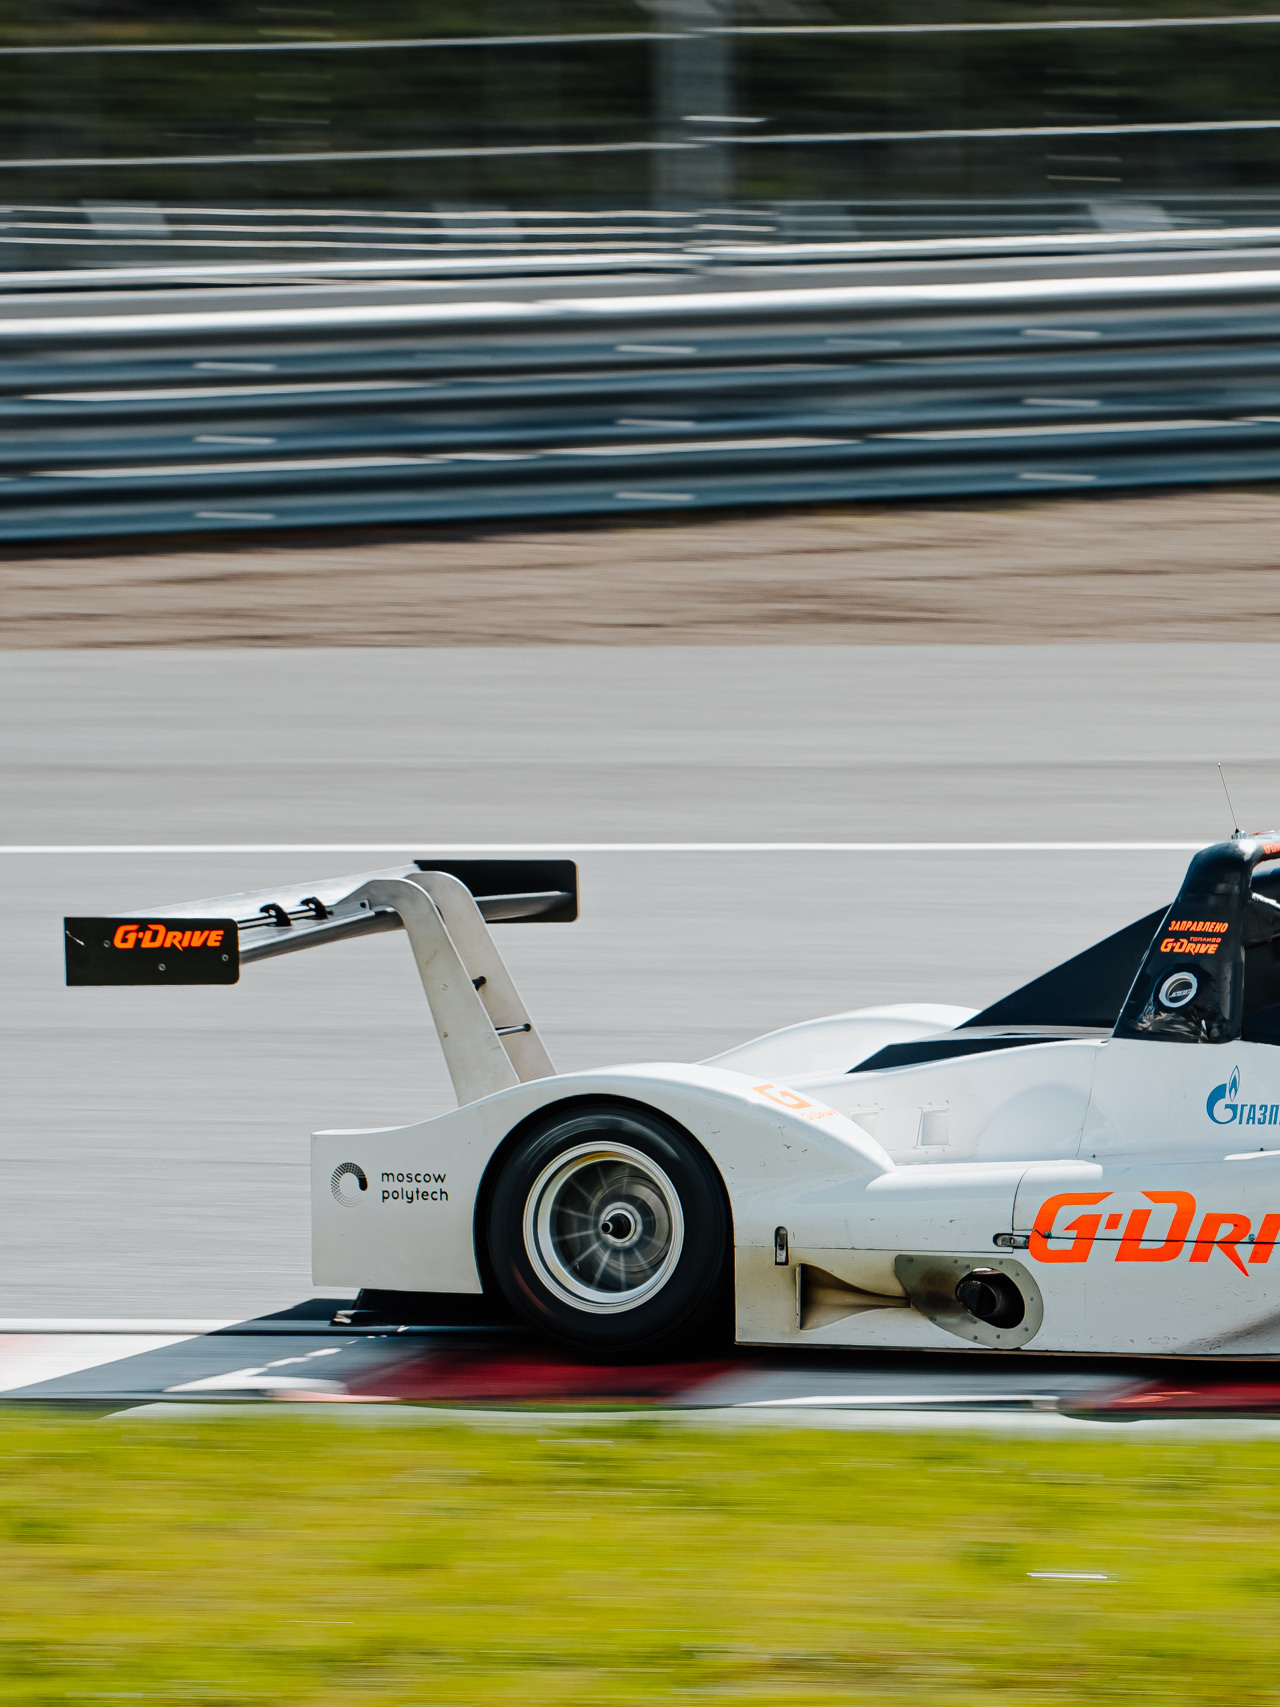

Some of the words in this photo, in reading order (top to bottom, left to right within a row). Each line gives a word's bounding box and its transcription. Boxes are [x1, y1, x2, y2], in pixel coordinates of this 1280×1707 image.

[1168, 920, 1229, 933] ЗАПРАВЛЕНО
[381, 1172, 447, 1183] moscow
[382, 1187, 449, 1204] polytech
